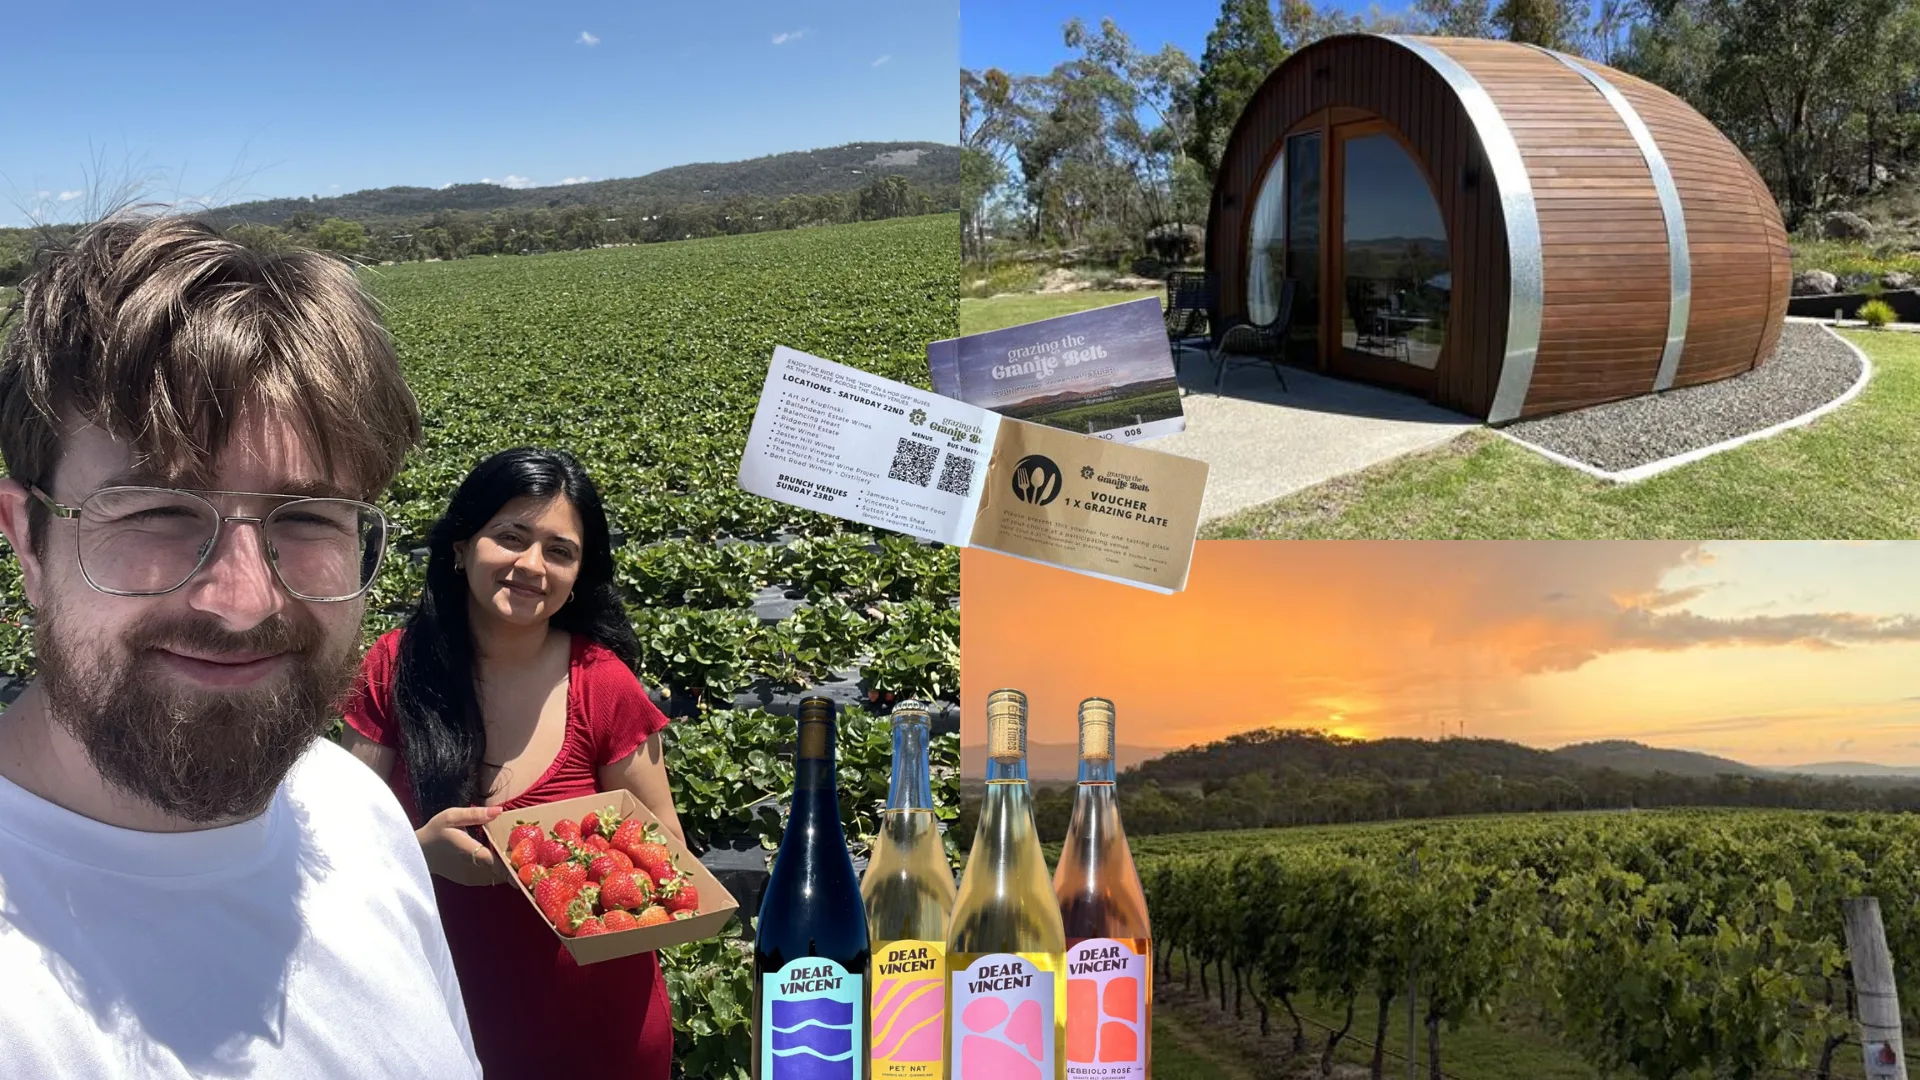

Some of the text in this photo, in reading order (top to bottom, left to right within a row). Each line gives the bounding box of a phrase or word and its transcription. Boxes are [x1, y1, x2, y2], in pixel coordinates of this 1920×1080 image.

[1008, 334, 1085, 363] grazing the
[991, 344, 1108, 380] Granite Belt
[796, 366, 810, 376] THEY
[810, 370, 833, 383] ROTATE
[834, 379, 858, 390] ACROSS
[858, 386, 870, 394] THE
[870, 389, 887, 399] MANY
[808, 364, 819, 372] THE
[834, 372, 844, 380] ON
[845, 376, 857, 385] THE
[782, 373, 832, 394] LOCATIONS
[838, 390, 882, 409] SATURDAY
[882, 404, 905, 416] 22ND
[788, 392, 800, 400] Art
[810, 398, 844, 414] Krupinski
[780, 414, 840, 436] Ridgemill Estate
[783, 408, 841, 429] Balancing Heart
[785, 400, 872, 430] Ballandean Estate Wines
[941, 416, 971, 433] grazing
[775, 429, 836, 452] Jester Hill Wines
[778, 422, 820, 438] View Wines
[911, 431, 934, 442] MENUS
[929, 421, 967, 442] Granite
[1124, 428, 1142, 438] 008
[774, 437, 840, 461] Flamehill Vineyard
[946, 441, 959, 450] BUS
[769, 452, 787, 462] Bent
[788, 456, 808, 468] Road
[808, 462, 834, 476] Winery
[840, 471, 872, 486] Distillery
[772, 444, 785, 454] The
[816, 457, 835, 468] Local
[836, 463, 855, 472] Wine
[856, 467, 880, 480] Project
[778, 473, 848, 498] BRUNCH VENUES
[1096, 474, 1150, 493] Granite Belt
[1106, 470, 1144, 482] grazing the
[775, 480, 834, 502] SUNDAY 23RD
[1090, 490, 1148, 512] VOUCHER
[864, 498, 900, 512] Vincenzo's
[866, 490, 947, 516] Jamworks Gourmet Food
[1064, 498, 1169, 528] 1 X GRAZING PLATE
[862, 504, 926, 526] Sutton's Farm Shed
[1026, 522, 1049, 532] choice
[1064, 532, 1108, 546] participating
[1028, 516, 1052, 526] present
[1070, 526, 1098, 536] voucher
[1098, 530, 1110, 538] for
[1126, 537, 1150, 548] tasting
[1152, 543, 1170, 552] plate
[1008, 726, 1018, 751] Times
[888, 948, 928, 962] DEAR
[1078, 946, 1120, 962] DEAR
[790, 965, 834, 982] DEAR
[878, 958, 937, 976] VINCENT
[978, 962, 1023, 980] DEAR
[1069, 957, 1129, 976] VINCENT
[780, 976, 844, 996] VINCENT
[968, 974, 1034, 994] VINCENT
[1111, 1066, 1132, 1074] ROSÉ
